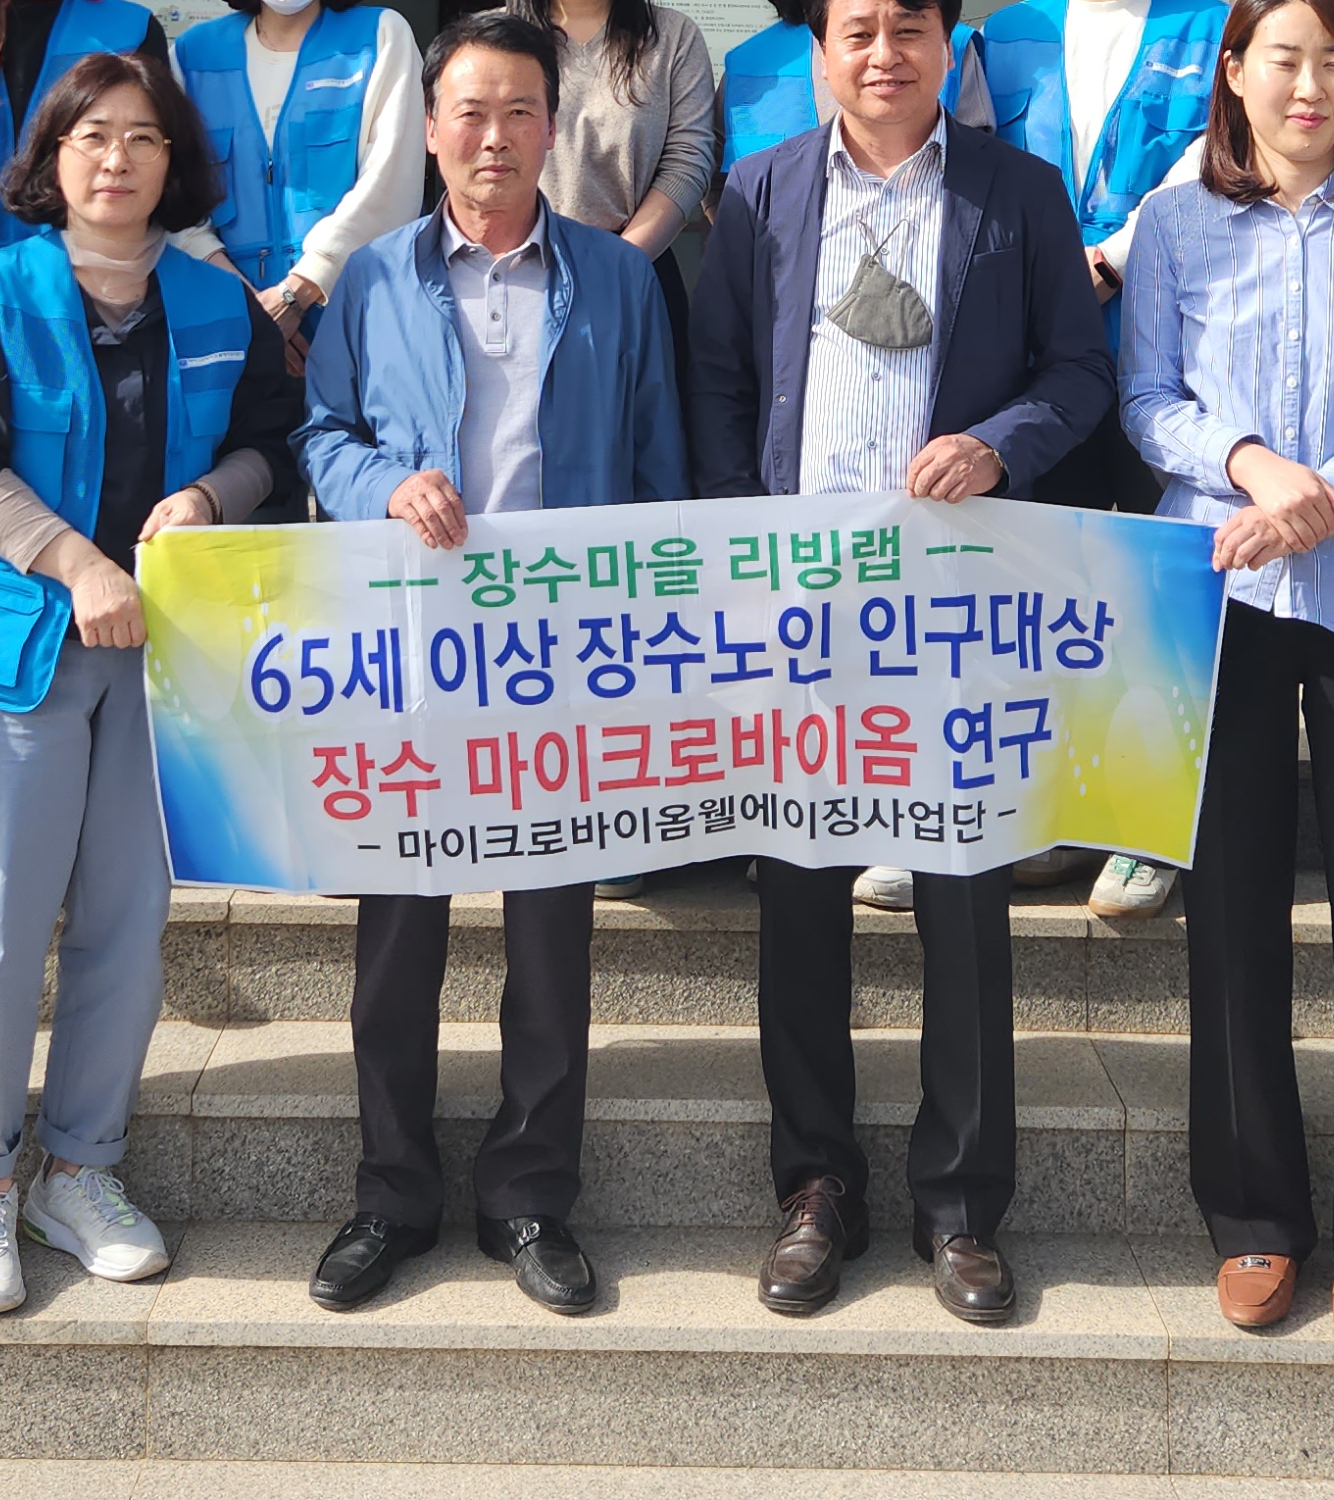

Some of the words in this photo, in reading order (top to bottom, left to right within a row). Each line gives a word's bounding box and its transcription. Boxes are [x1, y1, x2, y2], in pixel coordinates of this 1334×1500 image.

[461, 536, 704, 608] 장수마을
[728, 525, 902, 592] 리빙랩
[250, 627, 405, 716] 65세
[429, 617, 559, 708] 이상
[575, 601, 833, 700] 장수노인
[858, 591, 1116, 679] 인구대상
[311, 739, 442, 822] 장수
[466, 704, 919, 811] 마이크로바이옴
[942, 697, 1053, 791] 연구
